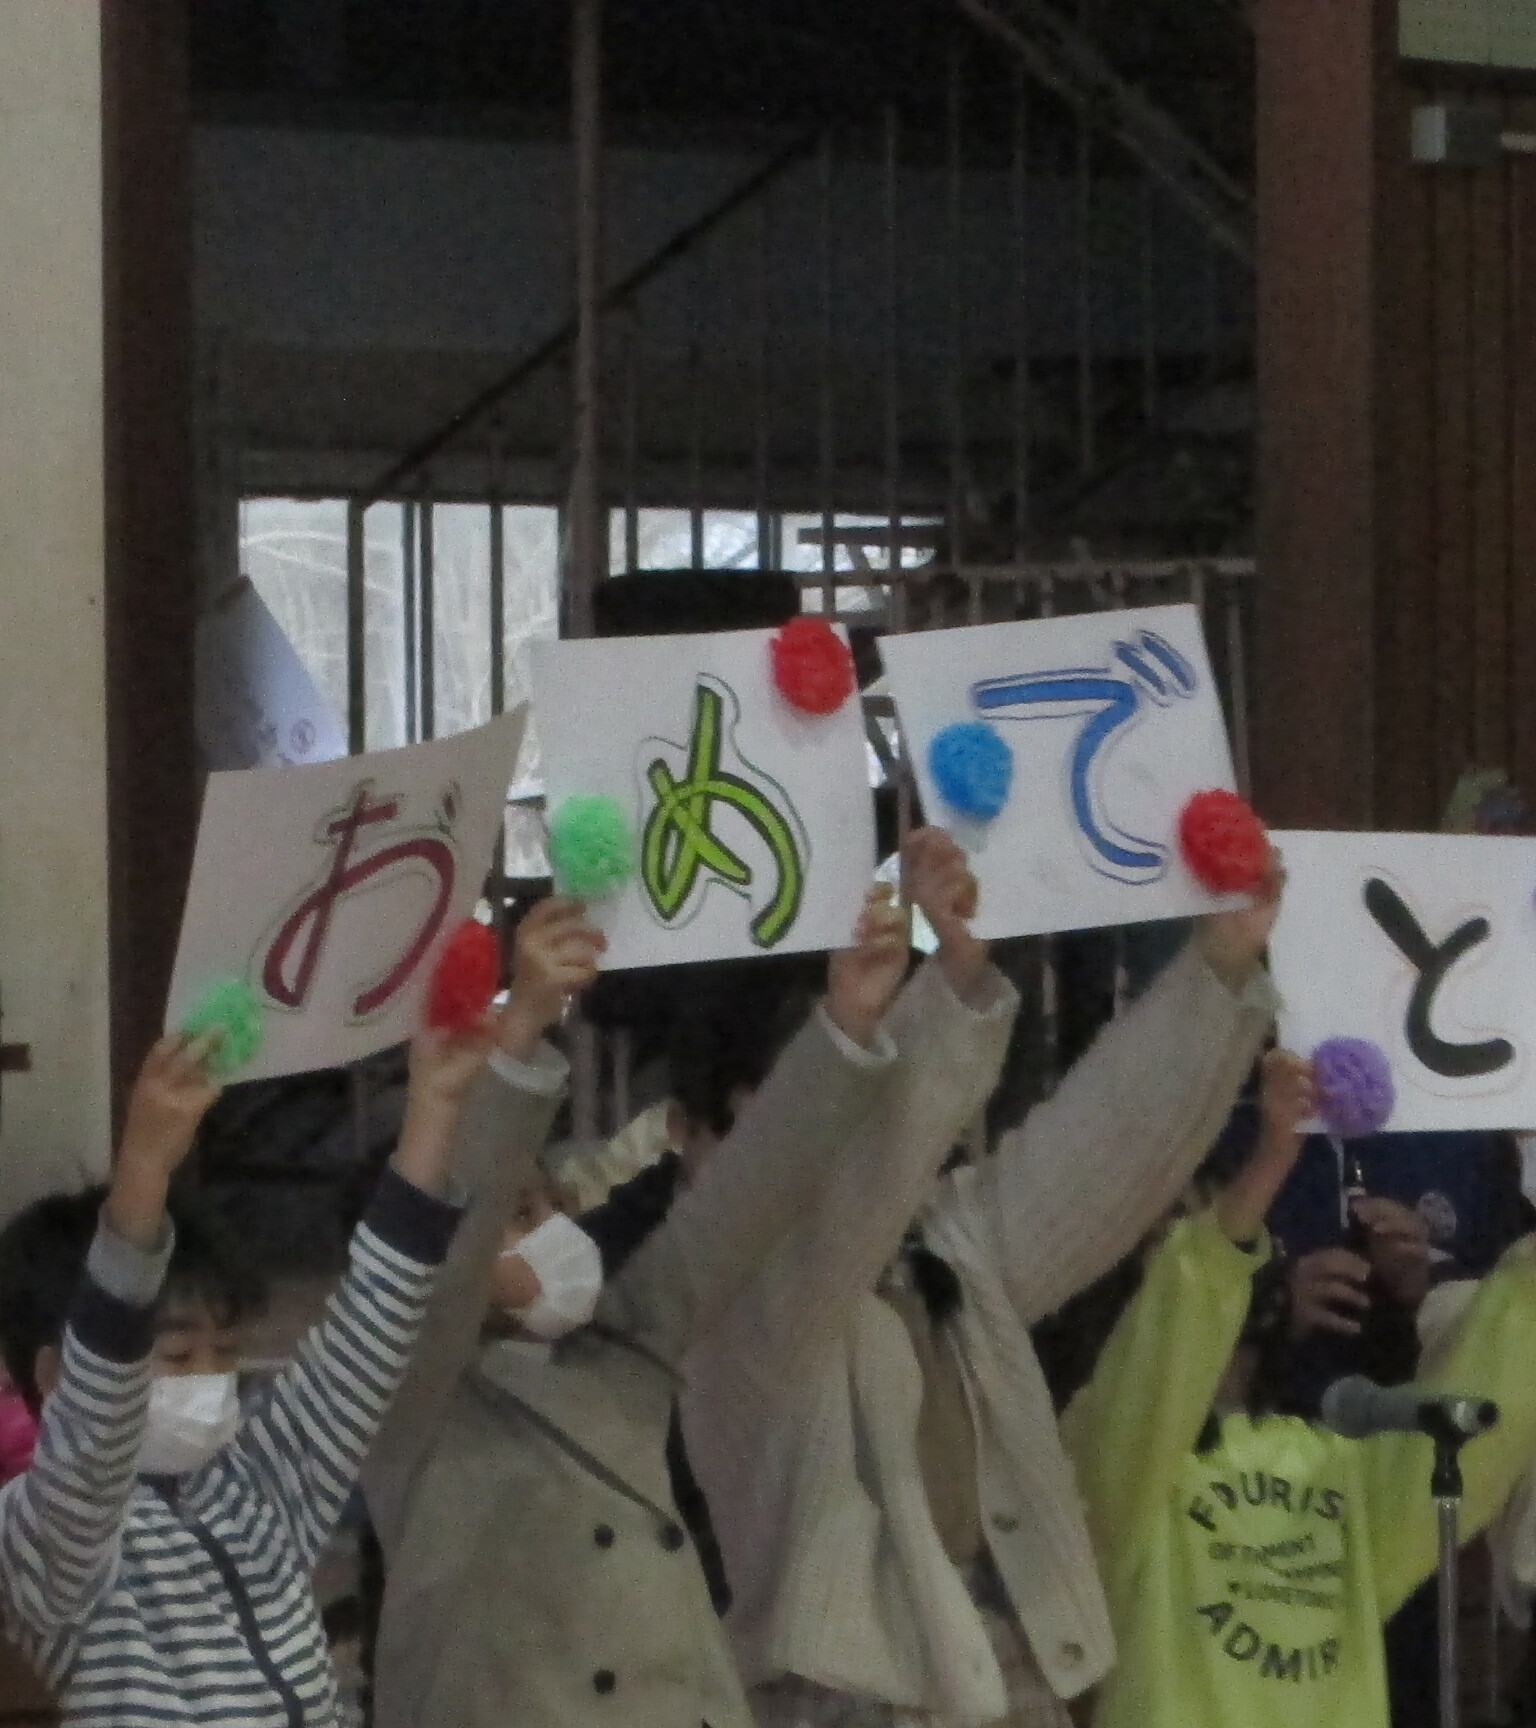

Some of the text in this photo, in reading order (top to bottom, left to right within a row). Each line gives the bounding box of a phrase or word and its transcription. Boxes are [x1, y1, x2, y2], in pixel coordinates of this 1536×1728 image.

[641, 674, 803, 947] め
[972, 632, 1195, 878] で
[261, 779, 457, 1016] お
[1363, 877, 1516, 1078] と
